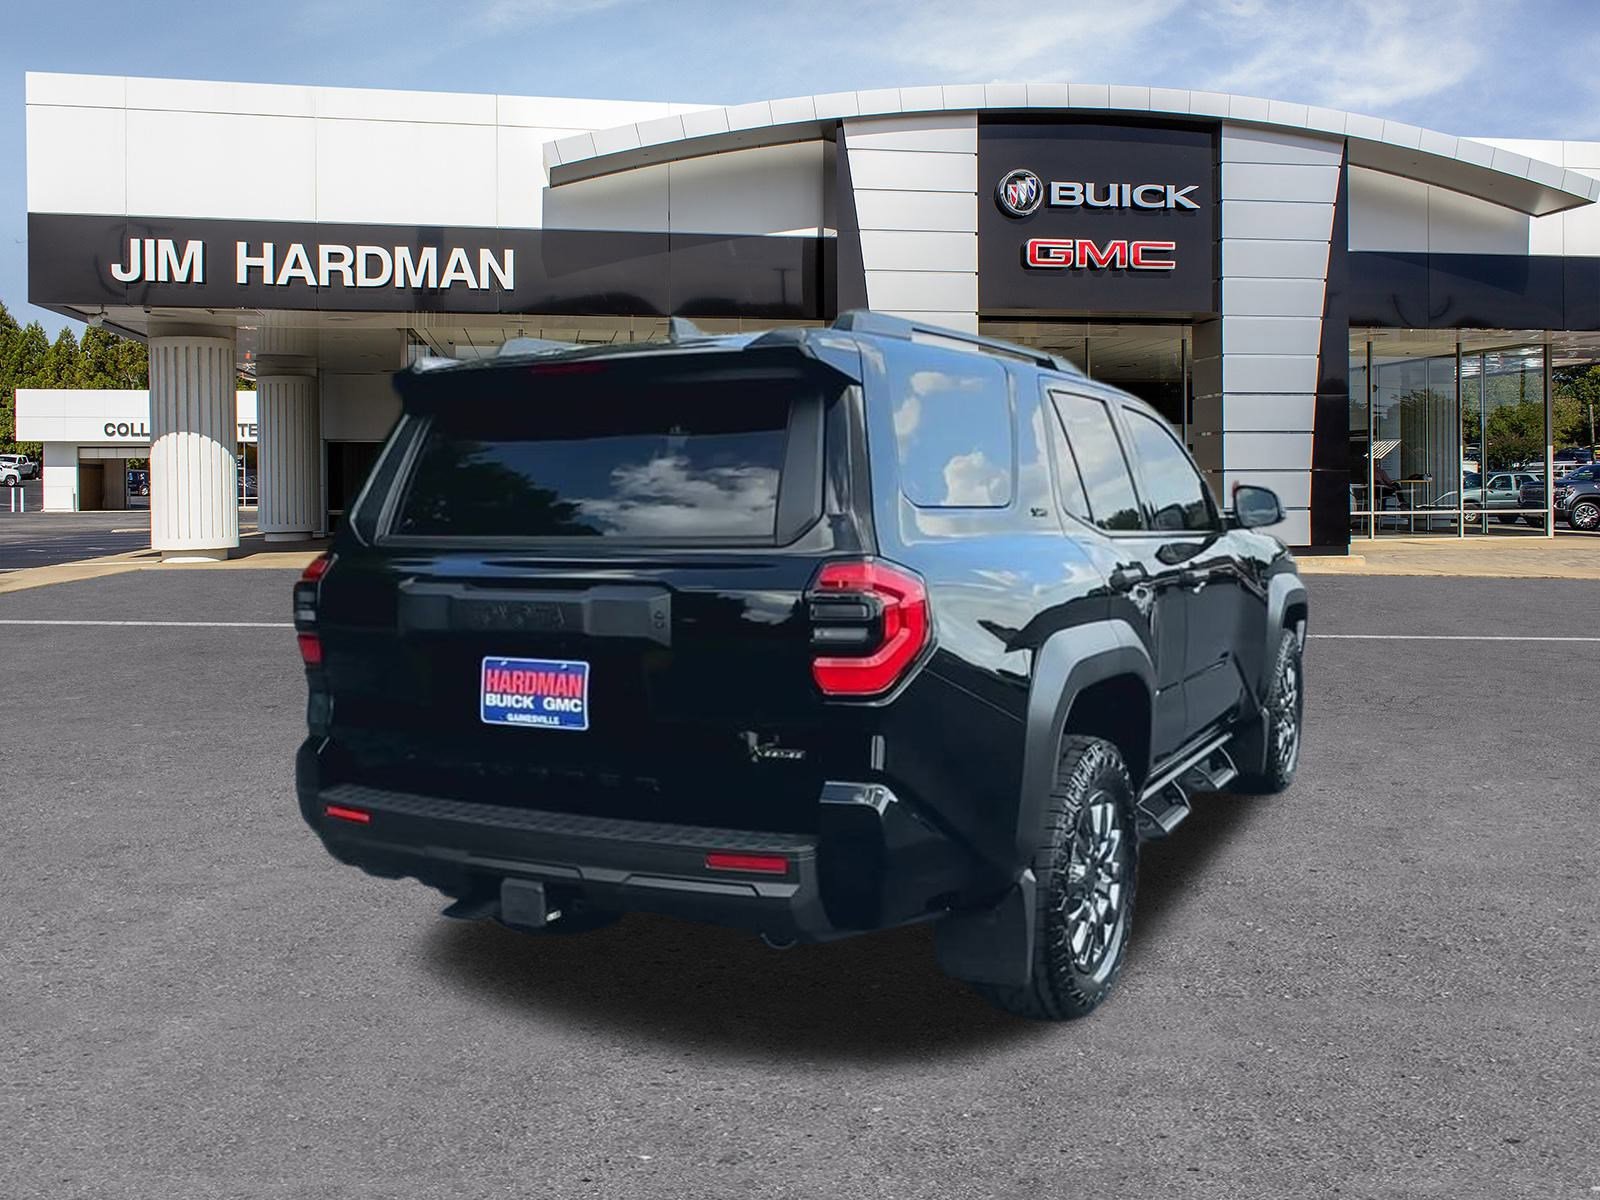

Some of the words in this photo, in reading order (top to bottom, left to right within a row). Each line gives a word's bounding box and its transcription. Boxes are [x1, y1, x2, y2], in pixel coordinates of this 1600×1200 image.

[1050, 181, 1200, 210] BUICK
[111, 238, 203, 284] JIM
[236, 241, 515, 291] HARDMAN
[1026, 238, 1176, 270] GMC
[486, 669, 582, 698] HARDMAN
[485, 693, 535, 710] BUICK
[543, 697, 583, 713] GMC
